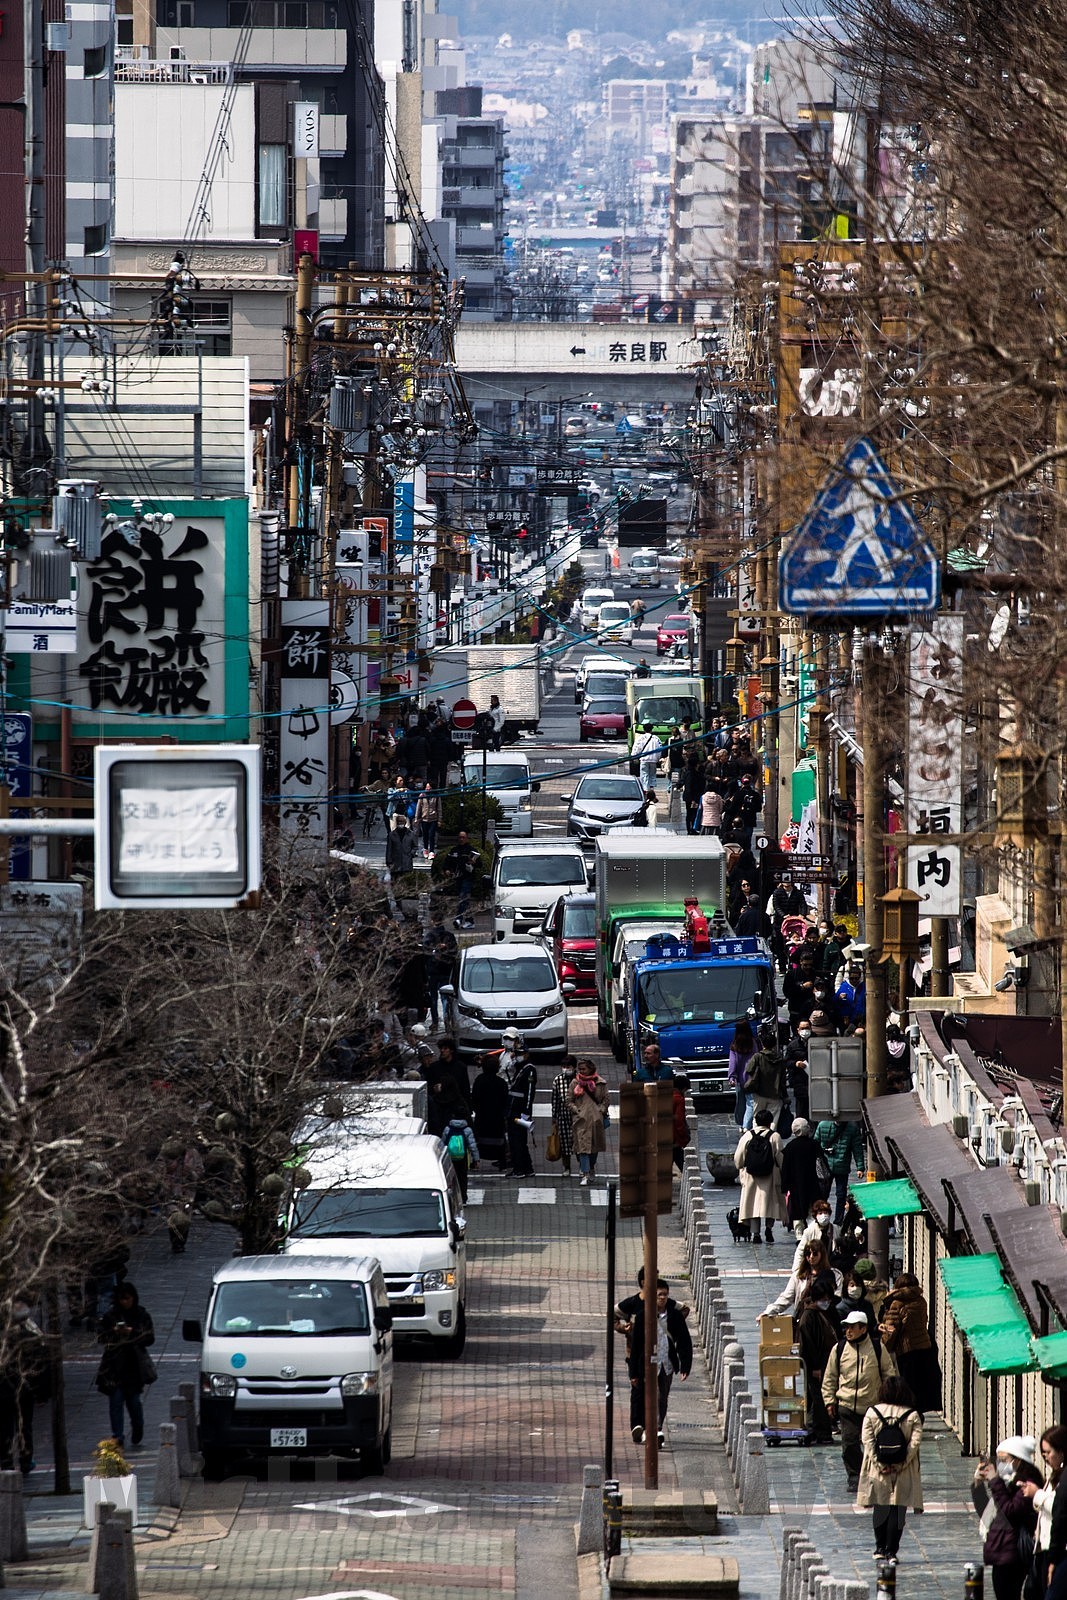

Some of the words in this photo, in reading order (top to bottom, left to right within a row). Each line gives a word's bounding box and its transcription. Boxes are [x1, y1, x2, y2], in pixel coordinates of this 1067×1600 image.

[305, 110, 315, 150] SOYON
[609, 340, 667, 362] 奈良駅
[537, 469, 583, 480] 歩車分離式
[487, 512, 531, 521] 歩車分離式
[8, 604, 74, 617] FamilyMart
[33, 634, 49, 651] 酒
[284, 630, 327, 674] 餅
[124, 800, 228, 820] 交通ルールを
[126, 842, 223, 860] 守りましょう
[694, 1045, 724, 1053] ISUZU
